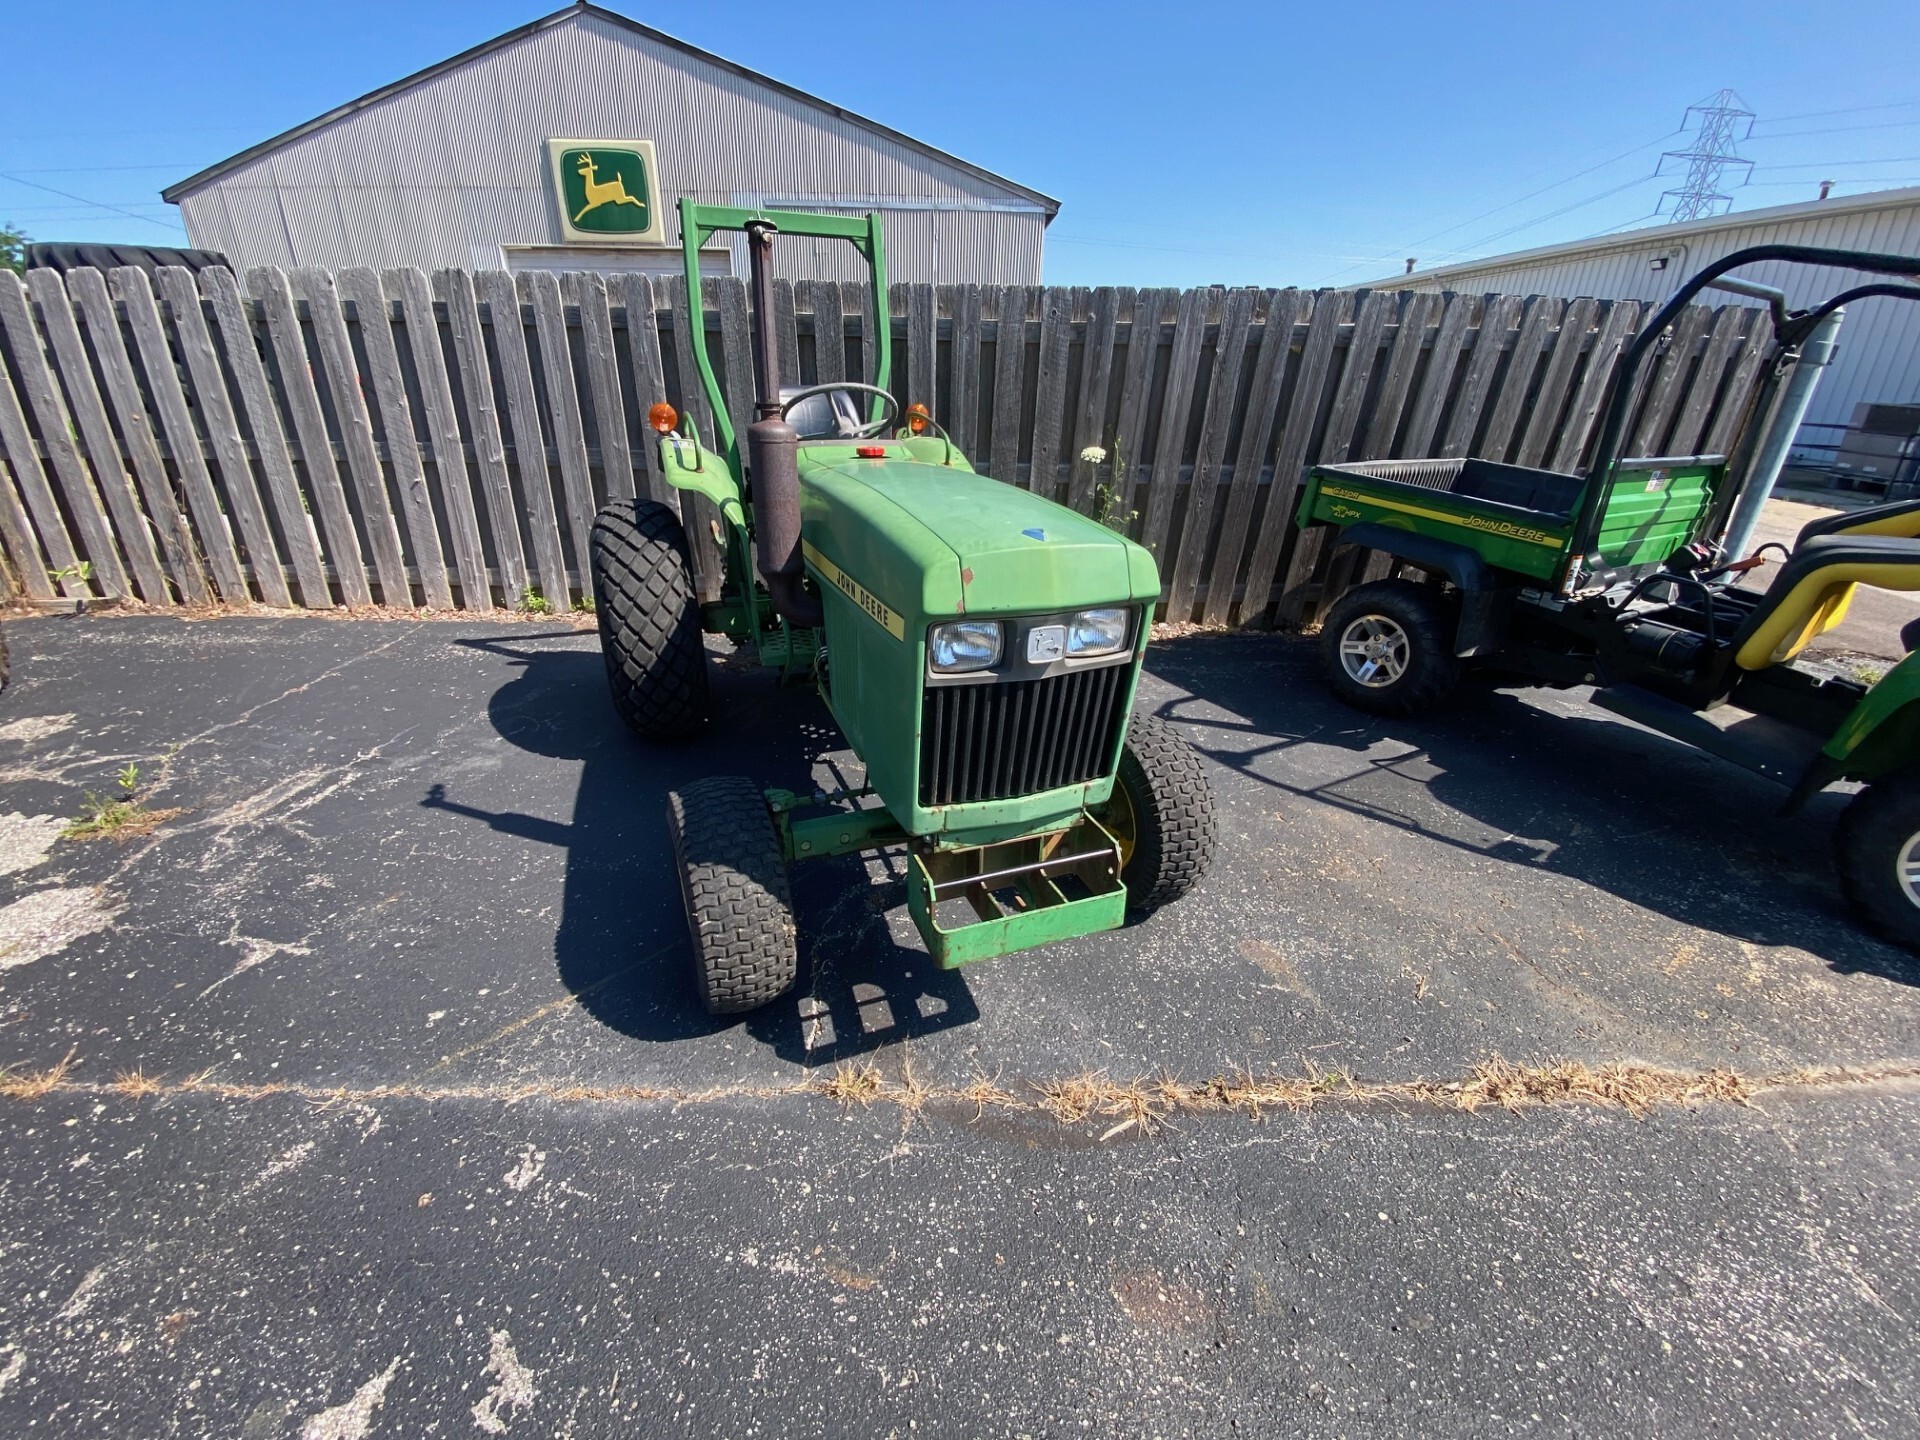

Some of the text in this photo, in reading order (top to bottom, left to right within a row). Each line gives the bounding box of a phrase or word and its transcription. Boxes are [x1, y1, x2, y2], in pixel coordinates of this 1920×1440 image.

[1332, 487, 1359, 499] GATOR
[1463, 515, 1546, 541] JOHN DEERE
[837, 571, 889, 627] JOHN DEERE
